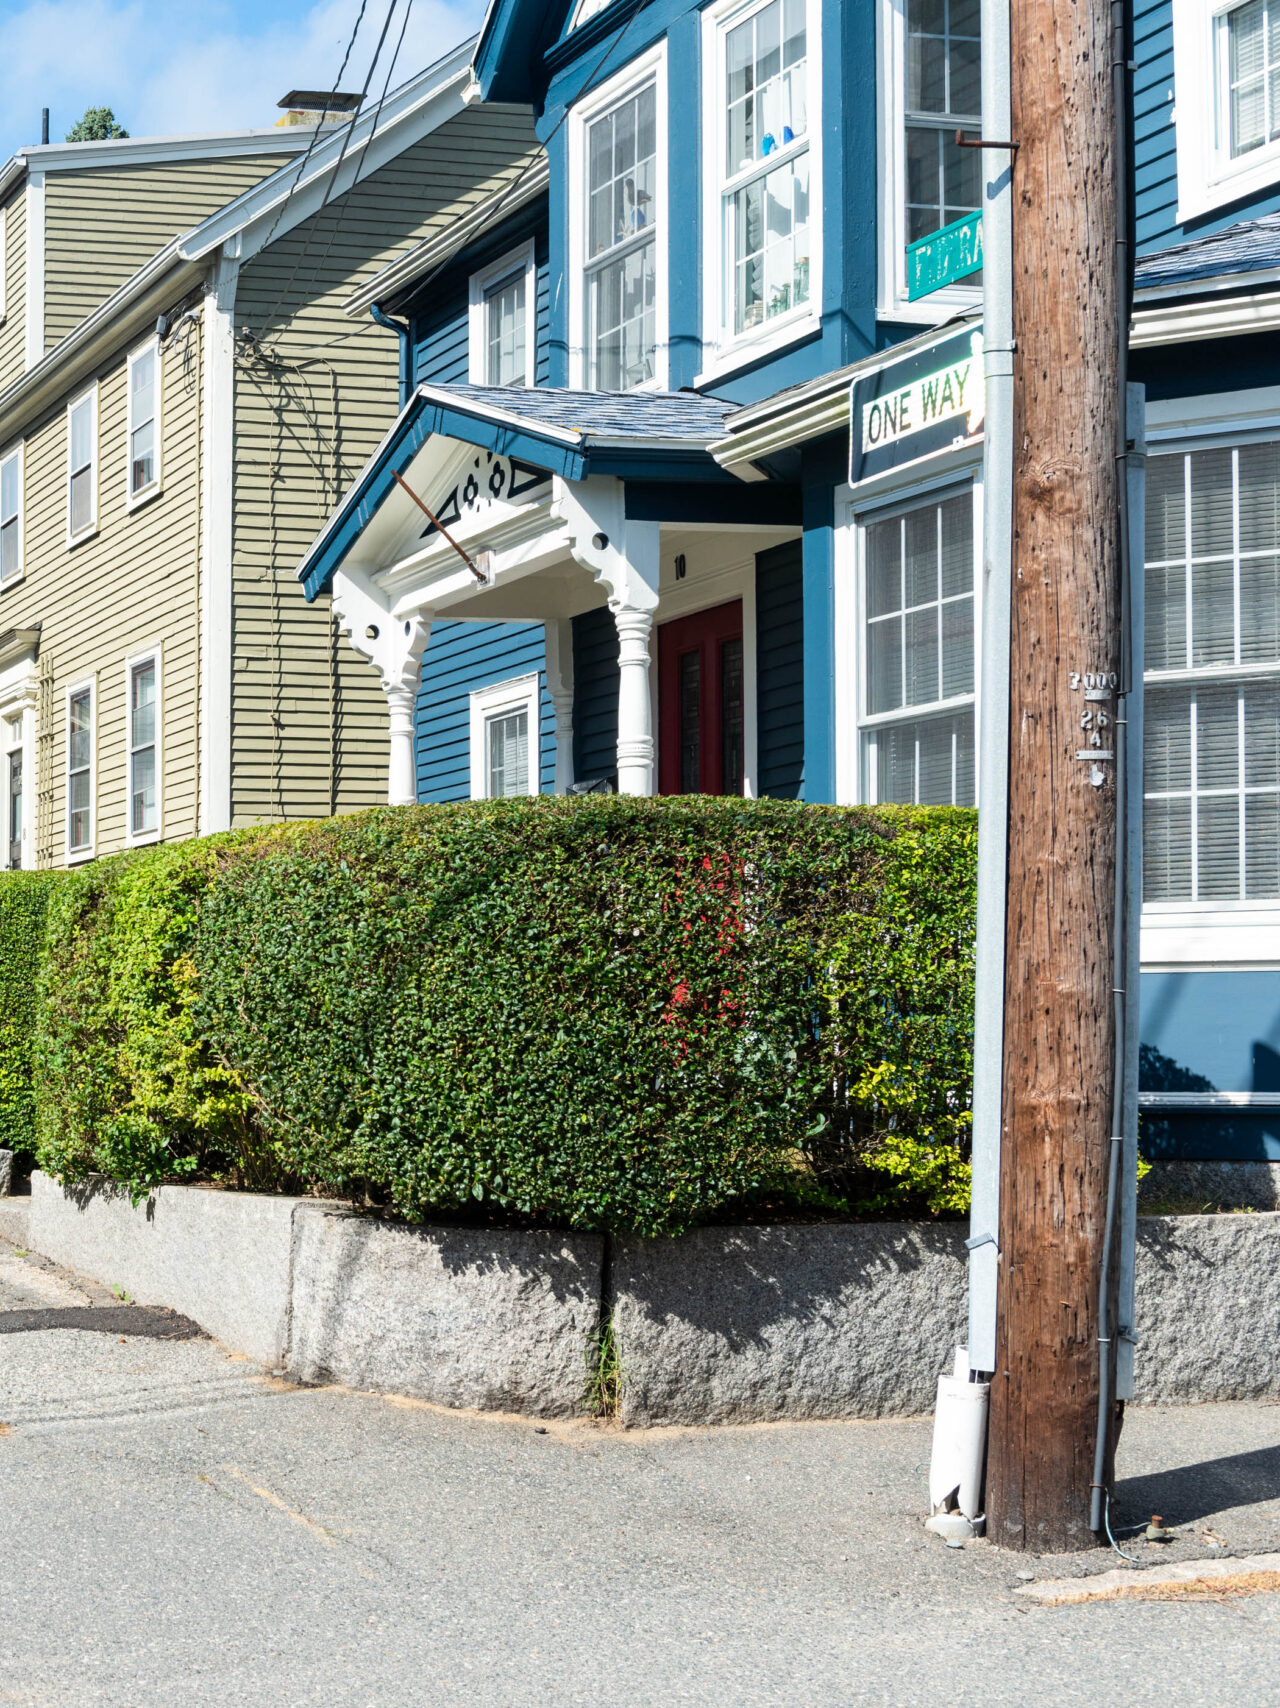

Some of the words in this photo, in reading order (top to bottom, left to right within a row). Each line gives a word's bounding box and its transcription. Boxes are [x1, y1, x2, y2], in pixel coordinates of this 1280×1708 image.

[869, 390, 911, 444] ONE
[922, 363, 970, 422] WAY
[674, 554, 686, 580] 10
[1080, 710, 1107, 729] 26
[1090, 730, 1101, 747] 4
